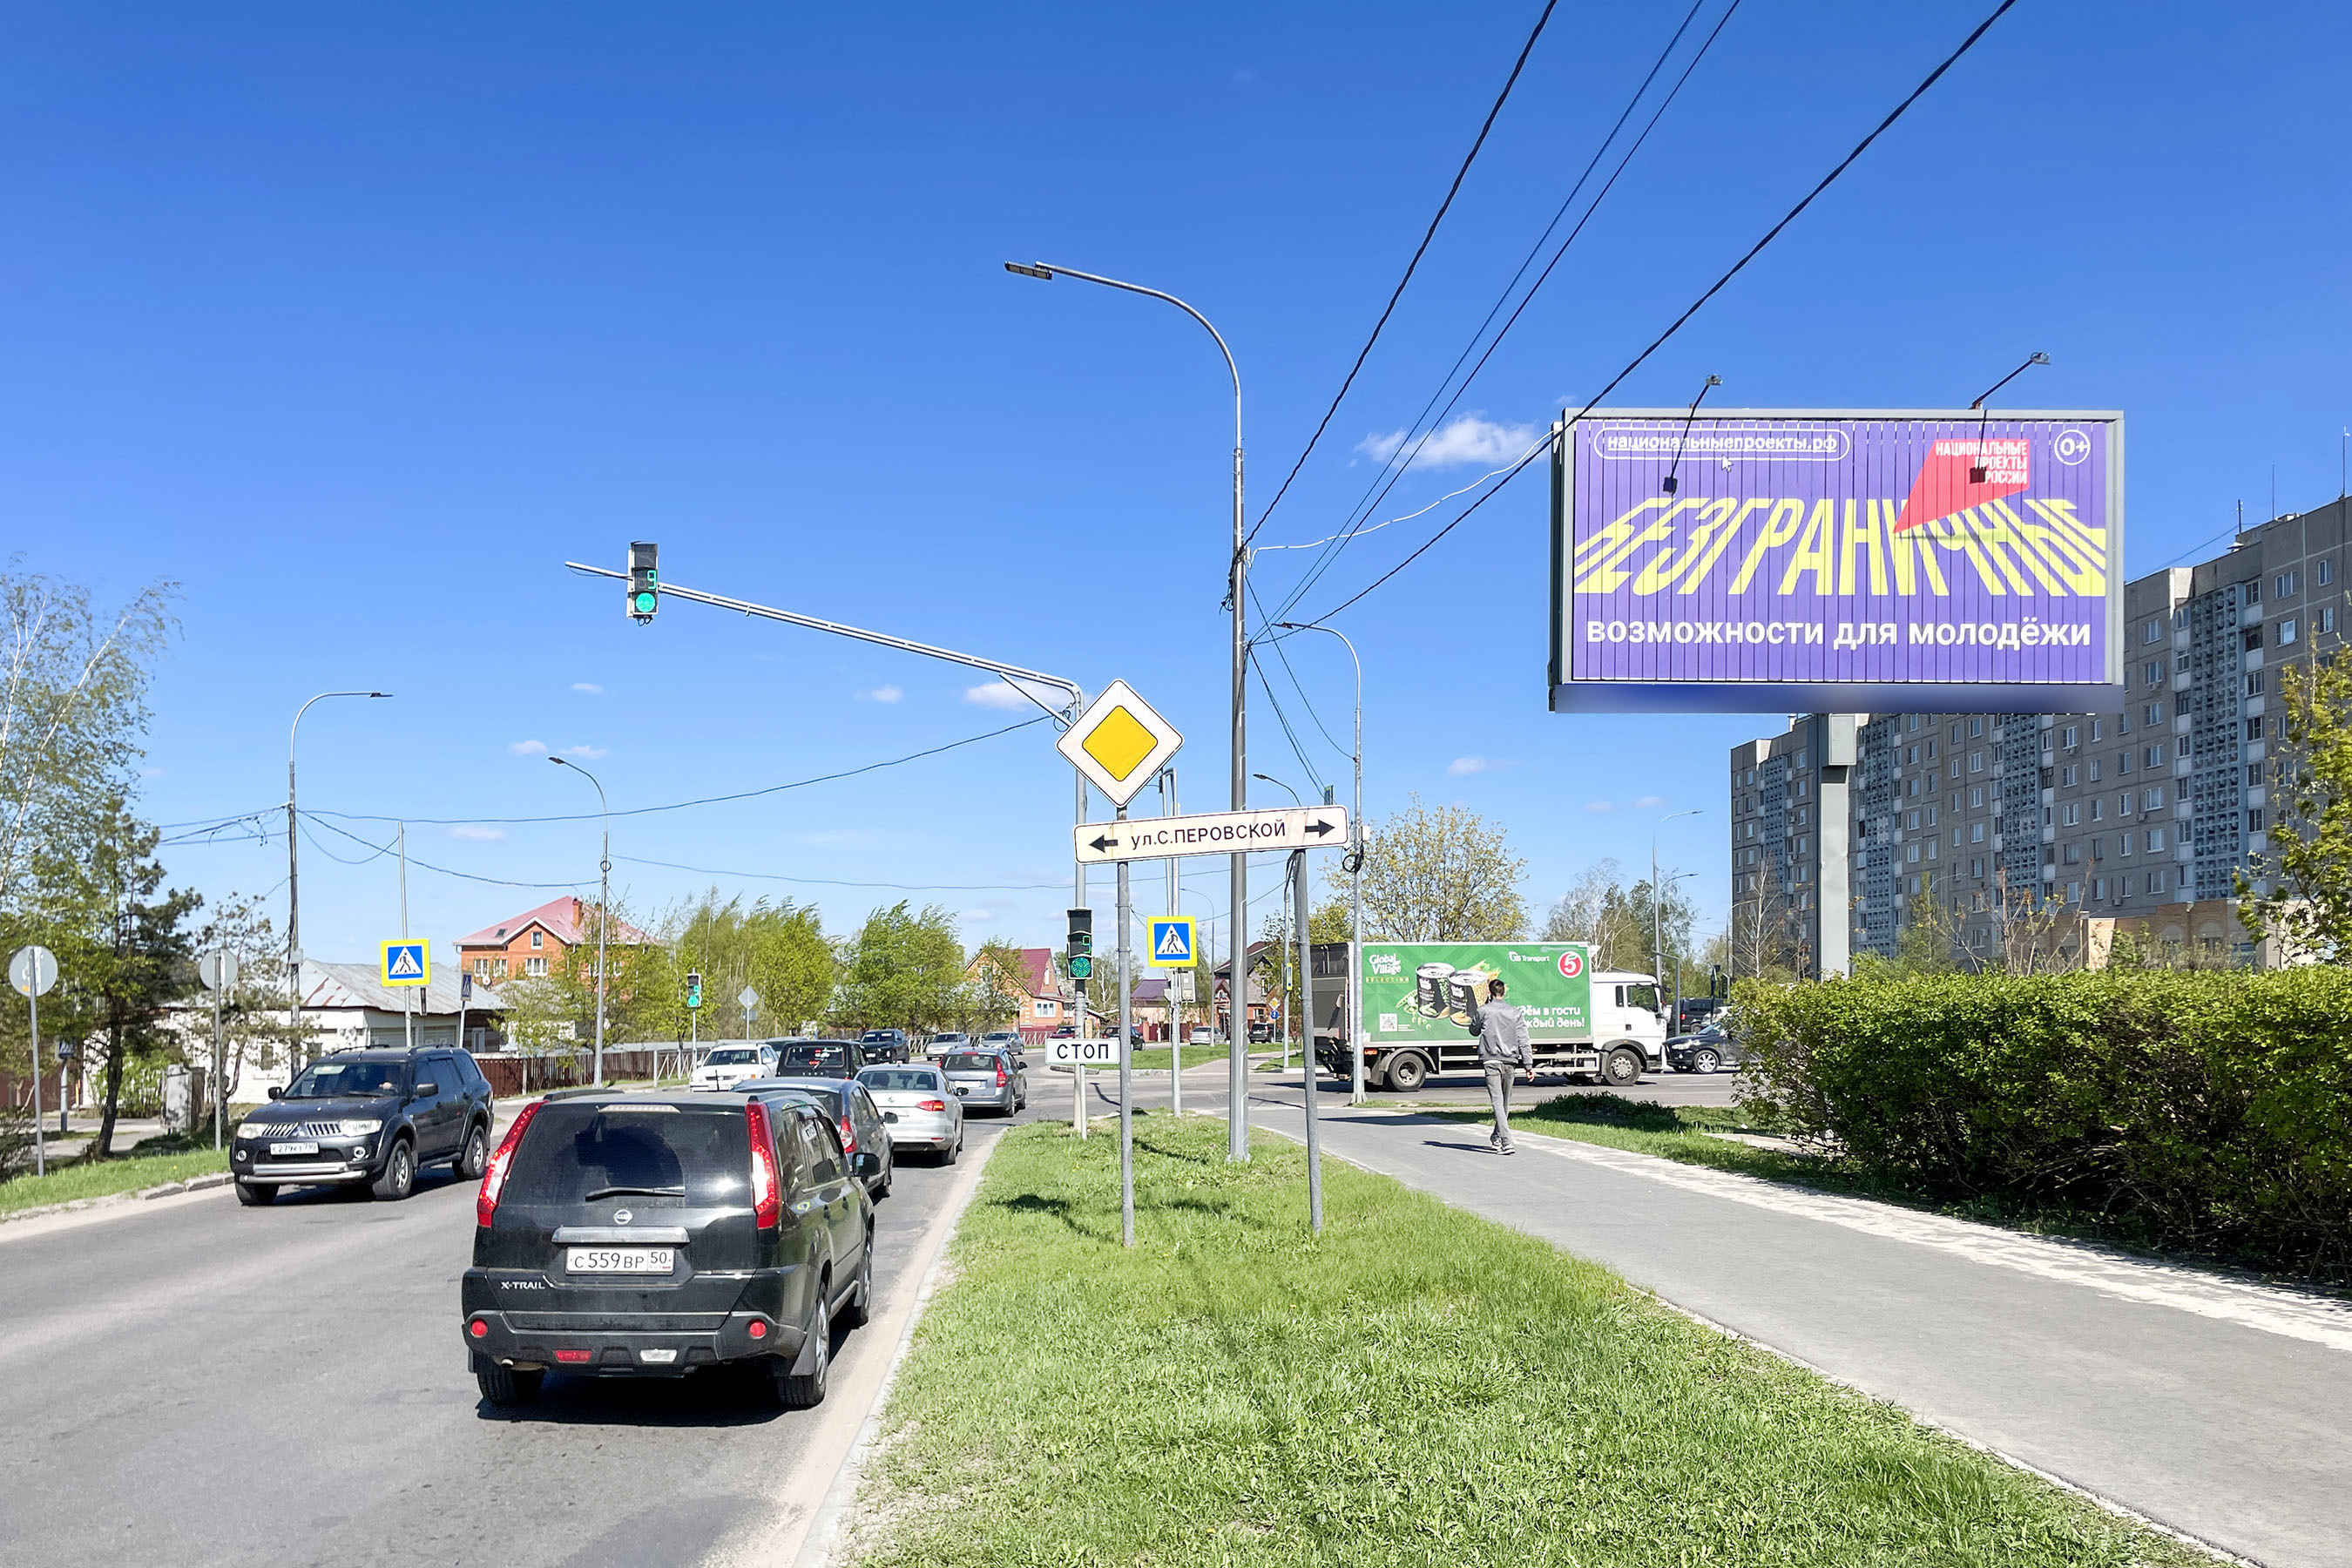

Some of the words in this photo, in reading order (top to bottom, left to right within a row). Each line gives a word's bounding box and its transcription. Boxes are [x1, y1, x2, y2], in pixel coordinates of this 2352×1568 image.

[1607, 434, 1837, 452] национальныепроекты.рф
[1936, 442, 2027, 457] НАЦИОНАЛЬНЫЕ
[2060, 438, 2088, 456] 0+
[1975, 457, 2027, 470] ПРОЕКТЫ
[1369, 953, 1397, 964] Global
[1372, 963, 1402, 975] Village
[1057, 1044, 1109, 1059] СТОП
